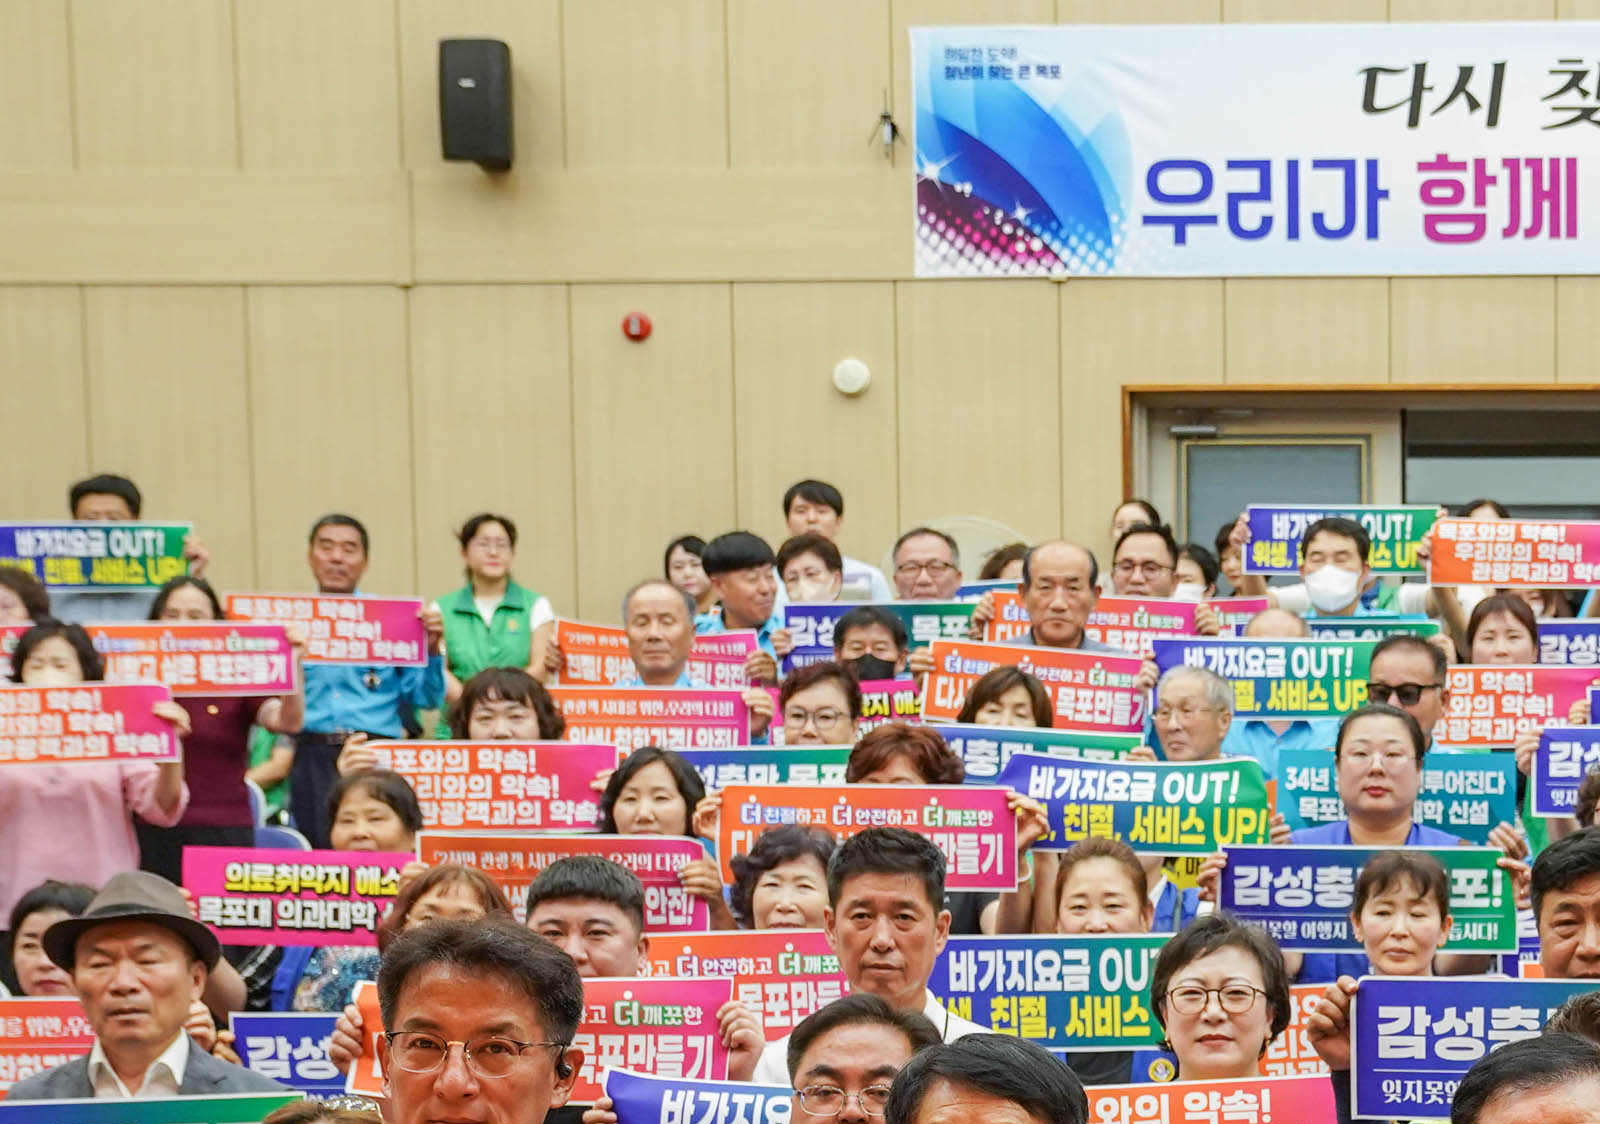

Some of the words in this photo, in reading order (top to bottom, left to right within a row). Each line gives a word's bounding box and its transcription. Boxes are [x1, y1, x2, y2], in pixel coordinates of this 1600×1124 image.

[1358, 61, 1507, 129] 다시
[1142, 158, 1389, 246] 우리가
[1417, 153, 1577, 244] 함께
[110, 529, 165, 557] OUT!
[1520, 524, 1566, 542] 약속!
[1455, 543, 1531, 562] 우리와의
[1537, 543, 1582, 563] 약속!
[1184, 646, 1287, 677] 바가지요금
[1291, 647, 1354, 677] OUT!
[1267, 681, 1331, 711] 서비스
[1480, 673, 1533, 694] 약속!
[1501, 694, 1554, 718] 약속!
[113, 735, 171, 762] 약속!
[478, 749, 537, 772] 약속!
[500, 775, 560, 799] 약속!
[1029, 764, 1155, 803] 바가지요금
[1162, 769, 1240, 805] OUT!
[1284, 768, 1330, 792] 34년
[1064, 805, 1123, 842] 친절,
[1130, 805, 1206, 846] 서비스
[1212, 806, 1268, 845] UP!
[1450, 801, 1489, 825] 신설
[223, 862, 349, 896] 의료취약지
[354, 865, 400, 898] 해소
[199, 896, 270, 928] 목포대
[277, 897, 376, 932] 의과대학
[645, 886, 695, 925] 안전!
[1300, 919, 1347, 942] 여행지
[968, 948, 1091, 993] 바가지요금
[642, 1003, 703, 1026] 깨끗한
[990, 995, 1057, 1039] 친절,
[1065, 995, 1151, 1038] 서비스
